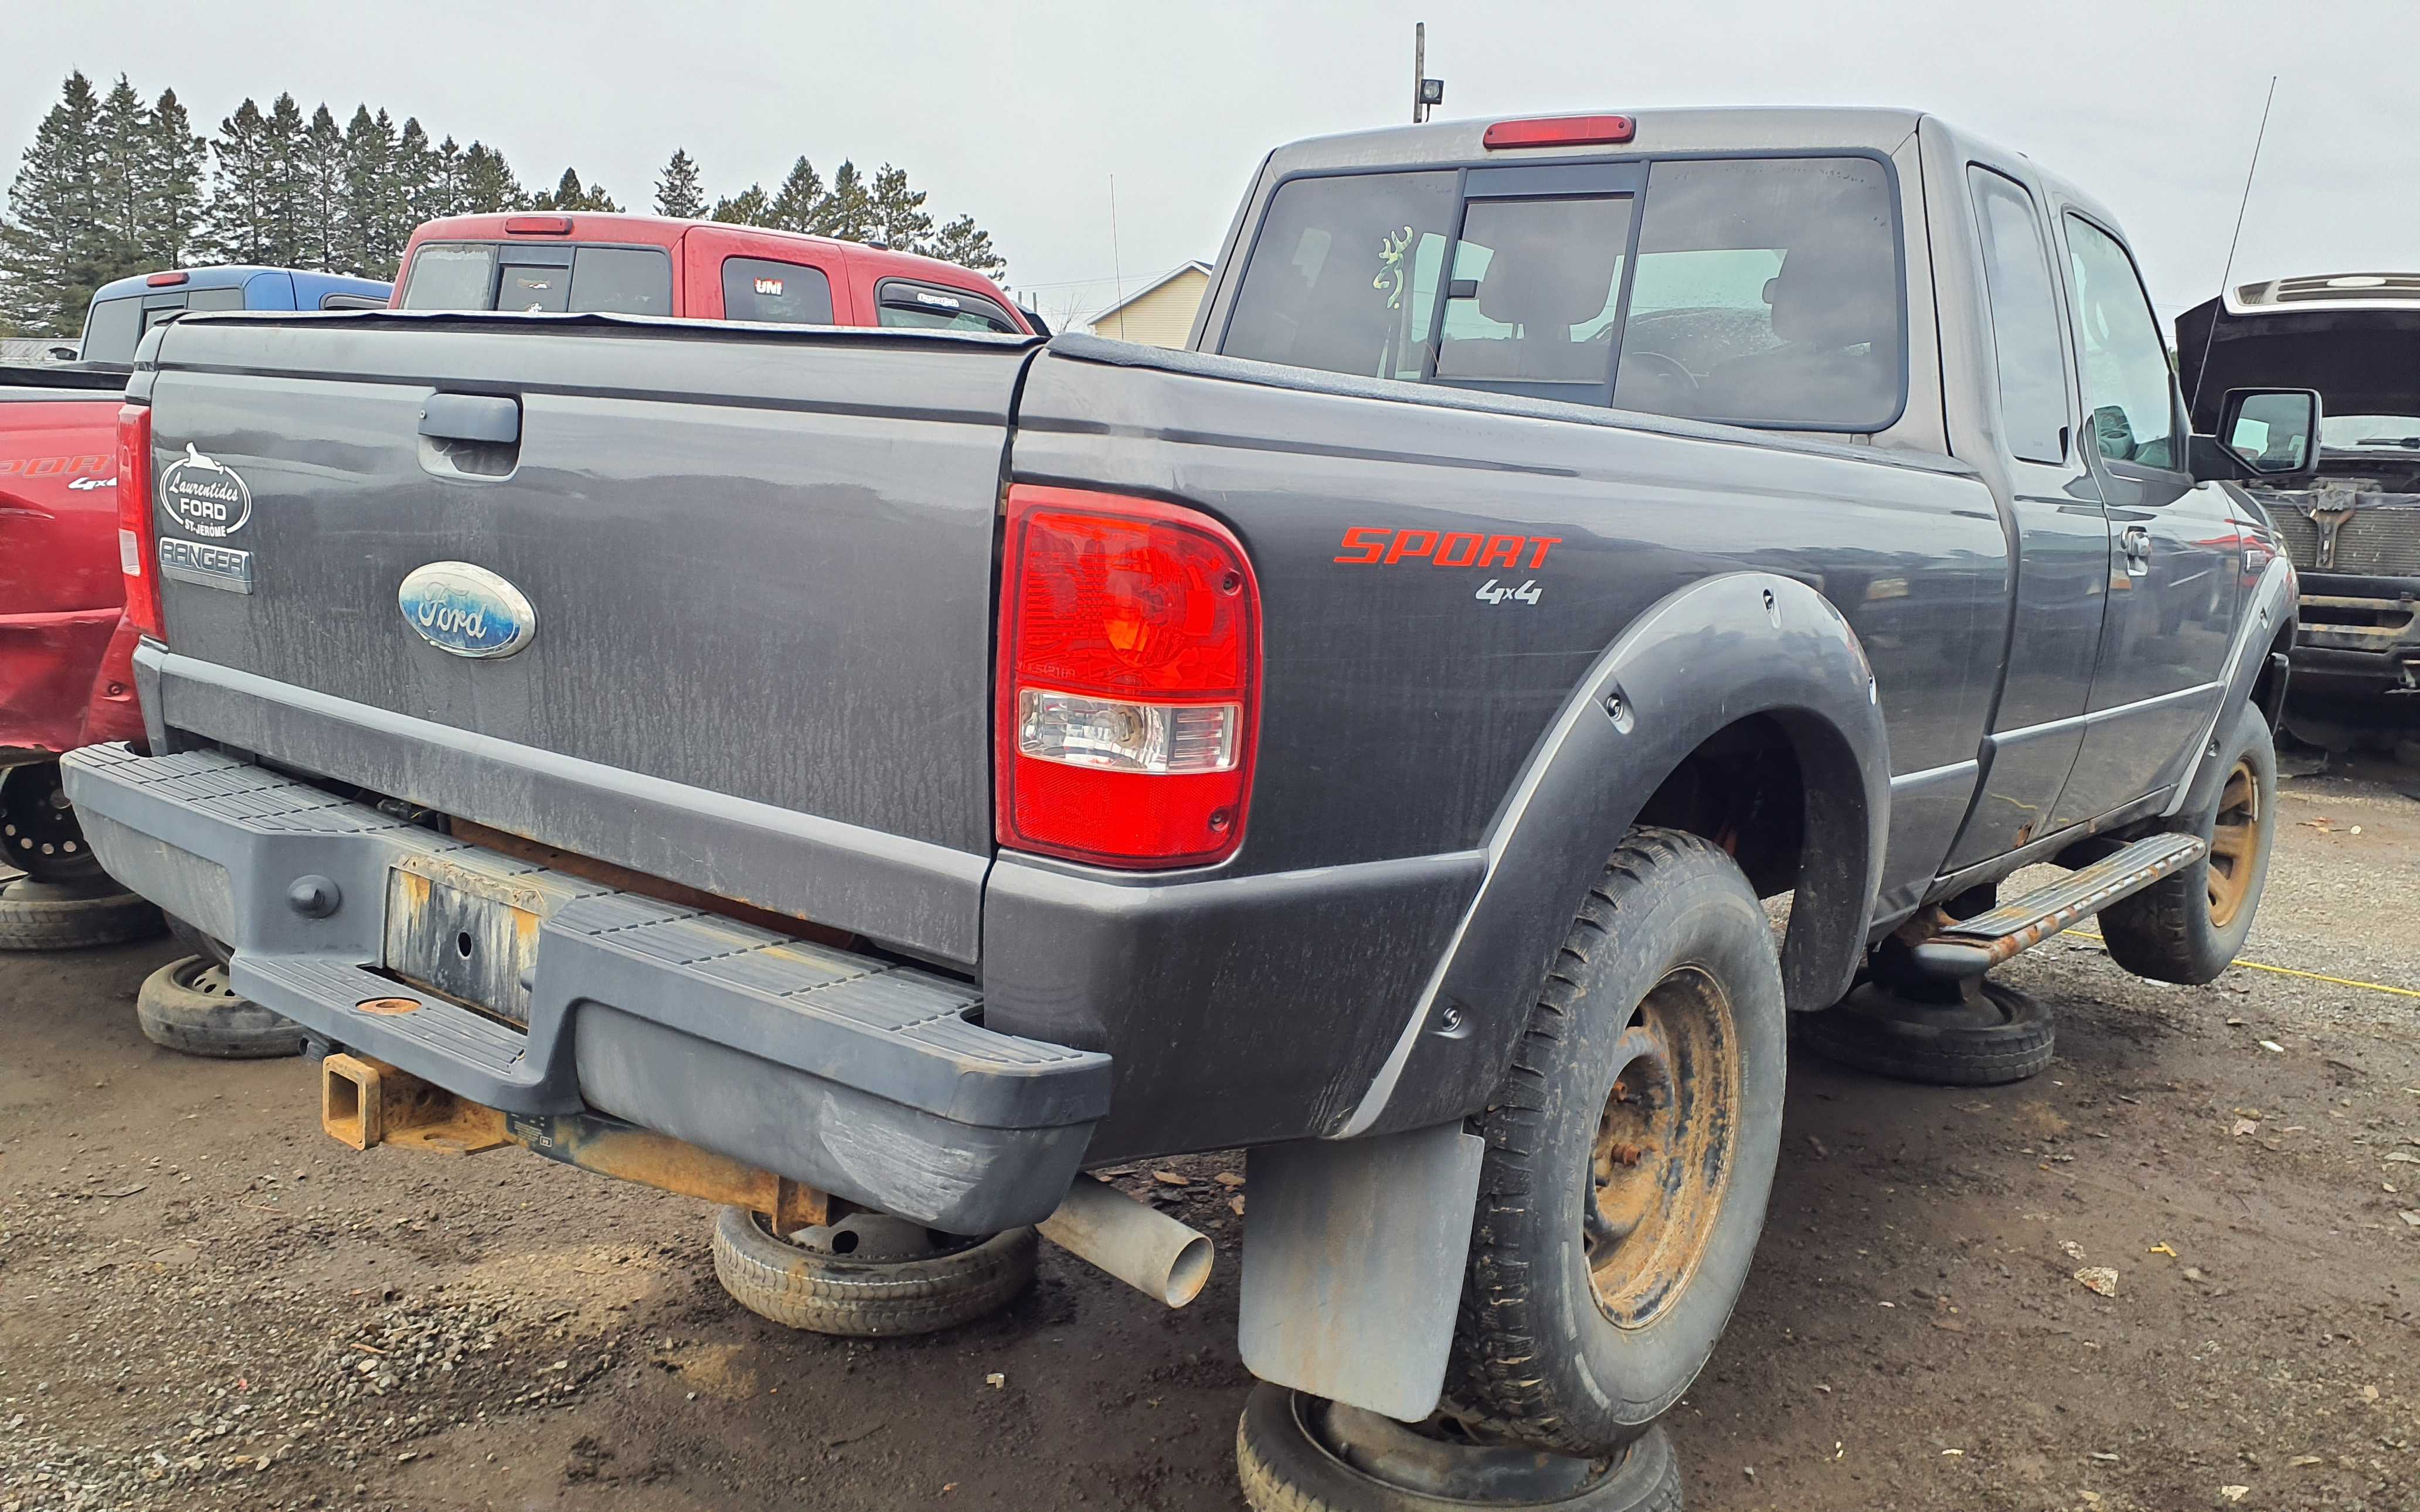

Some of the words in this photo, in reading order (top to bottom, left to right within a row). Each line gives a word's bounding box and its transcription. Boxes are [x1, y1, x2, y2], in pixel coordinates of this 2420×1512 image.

[169, 471, 238, 501] Laurentides
[180, 498, 226, 520] FORD
[161, 540, 243, 577] RANGER
[1333, 526, 1563, 570] SPORT
[1475, 578, 1543, 605] 4x4
[417, 581, 488, 640] Ford
